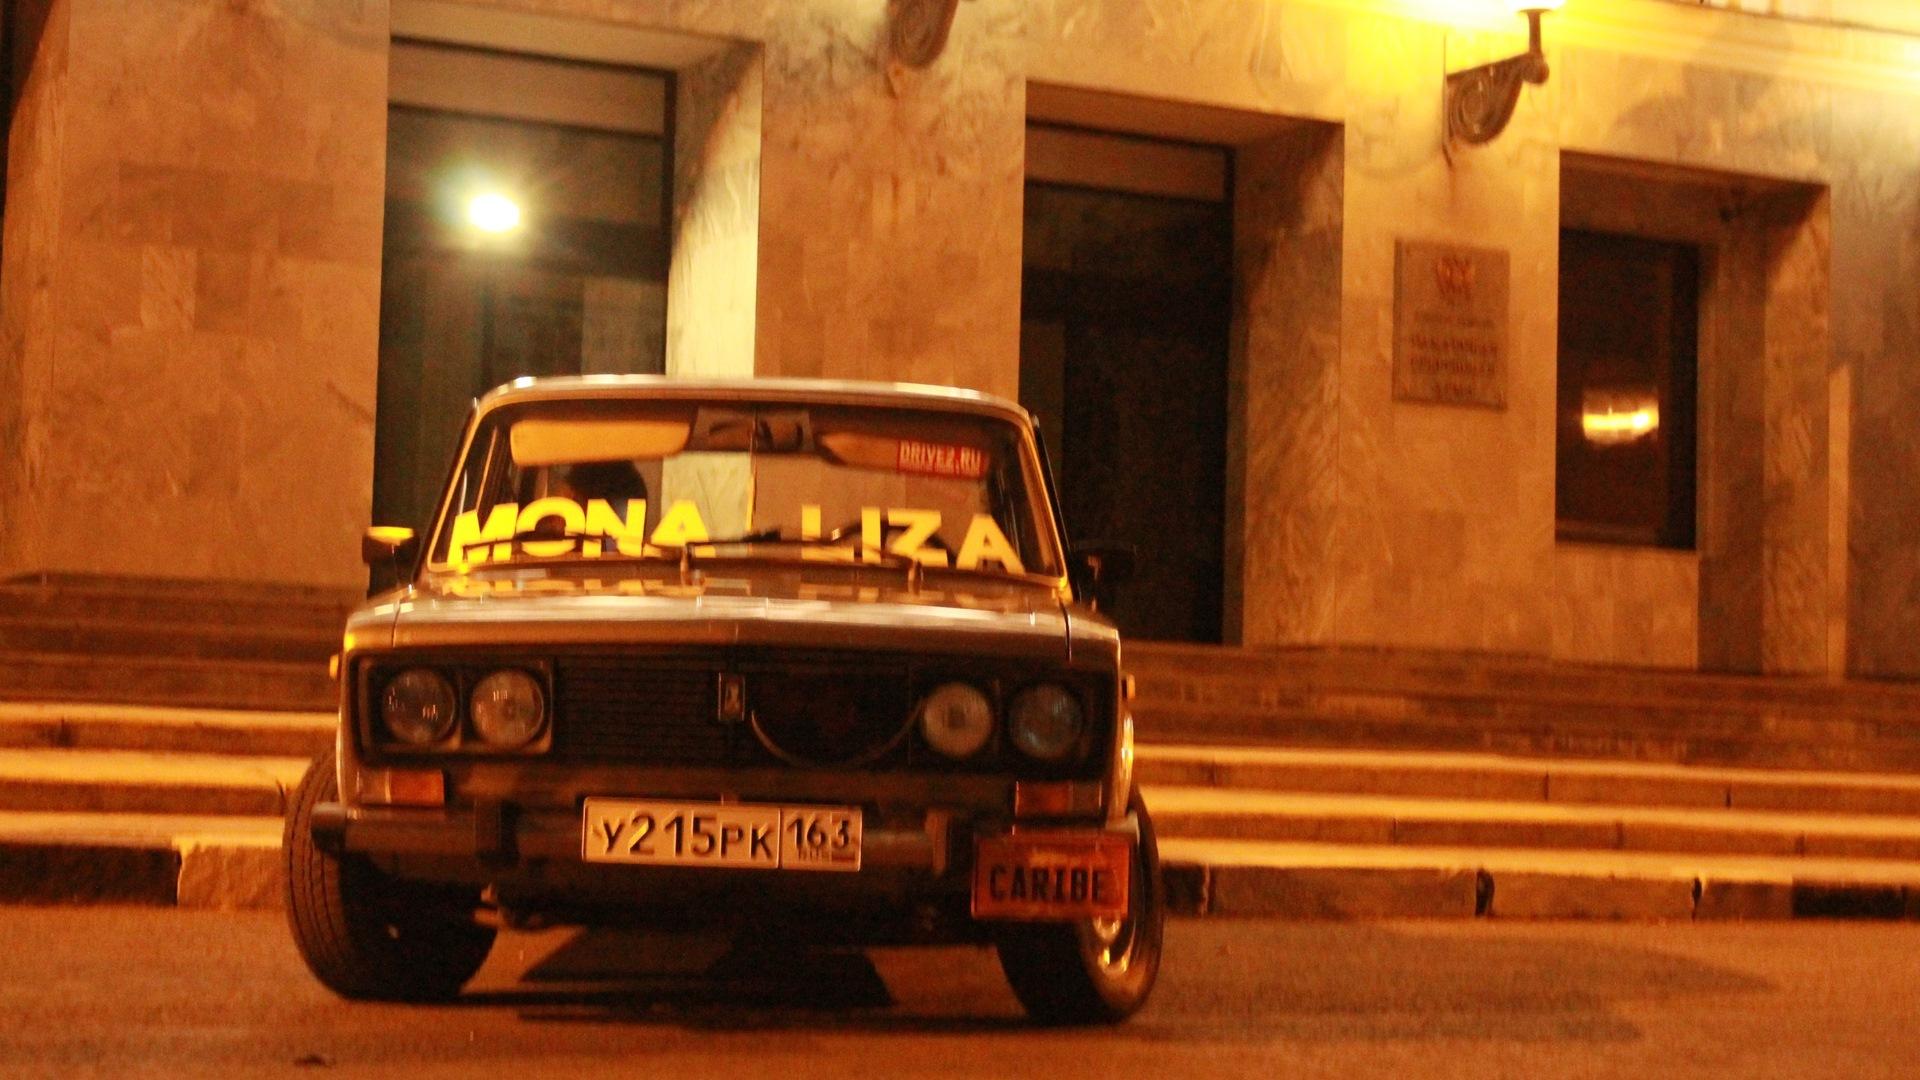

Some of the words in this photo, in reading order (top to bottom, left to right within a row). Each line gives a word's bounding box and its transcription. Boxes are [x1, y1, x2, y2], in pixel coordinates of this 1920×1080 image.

[899, 440, 981, 475] DRIVE2.RU
[446, 496, 717, 568] MONA
[800, 503, 1026, 575] LIZA
[786, 810, 849, 850] 163
[988, 864, 1112, 904] CARIBE
